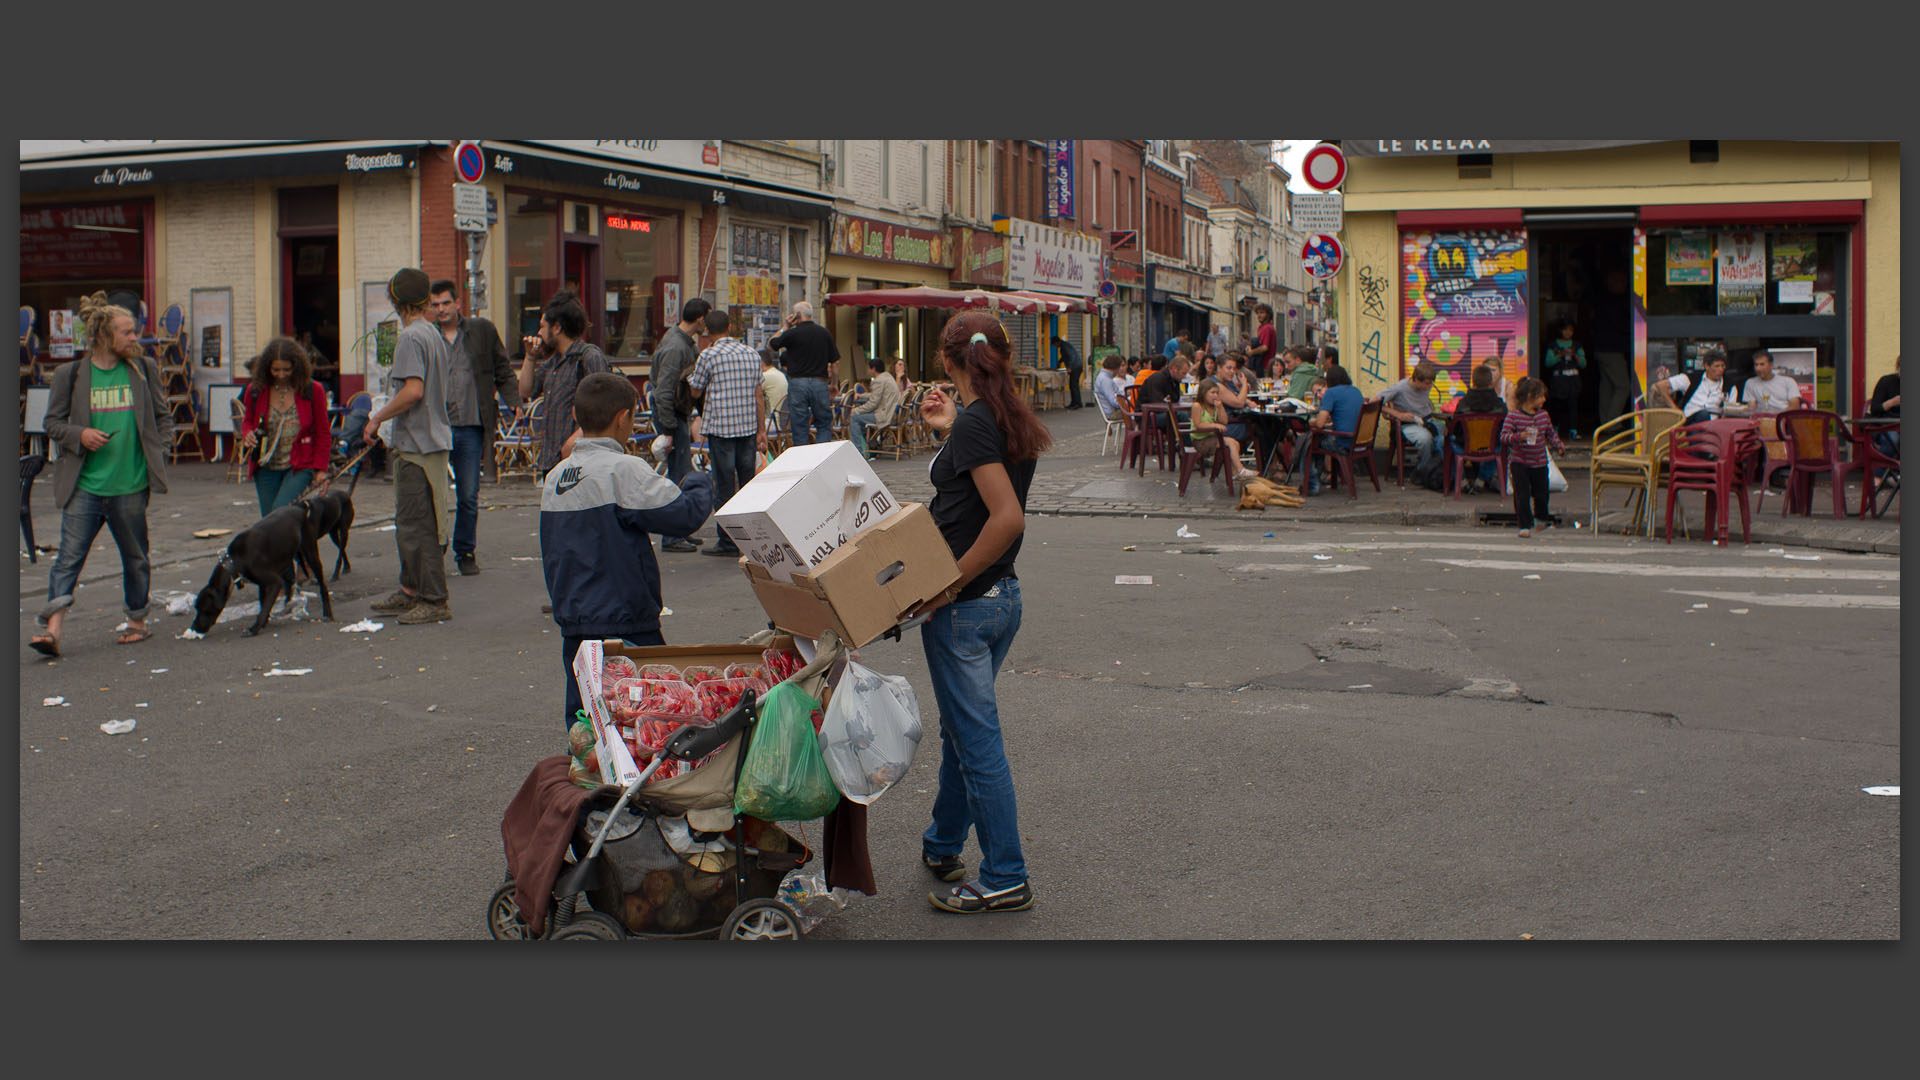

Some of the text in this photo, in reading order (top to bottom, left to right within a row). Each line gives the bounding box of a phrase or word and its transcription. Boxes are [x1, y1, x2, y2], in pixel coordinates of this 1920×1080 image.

[93, 165, 153, 185] Au Presto
[617, 174, 641, 191] Presto
[863, 221, 930, 264] Les 4 saisons
[560, 466, 583, 483] NIKE
[809, 541, 836, 566] FUN
